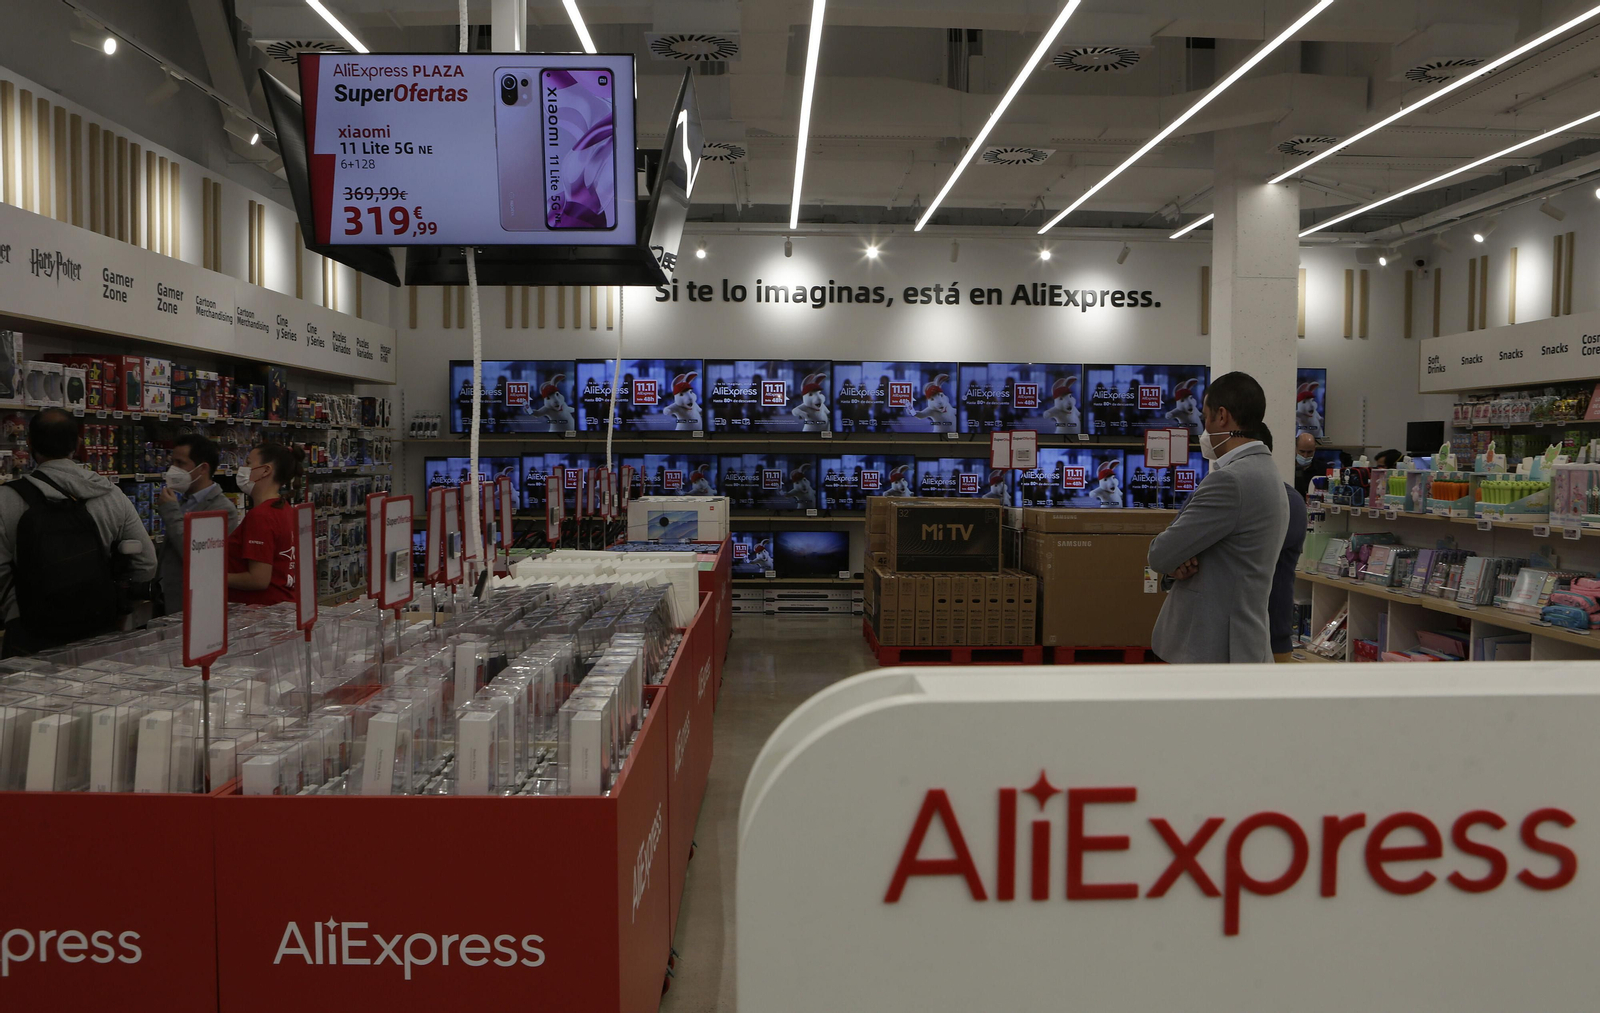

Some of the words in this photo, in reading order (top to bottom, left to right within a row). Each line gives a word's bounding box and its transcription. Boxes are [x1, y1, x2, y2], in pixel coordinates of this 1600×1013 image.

[333, 63, 408, 81] AliExpress
[413, 65, 464, 77] PLAZA
[334, 82, 468, 106] SuperOfertas
[338, 125, 391, 138] xiaomi
[340, 142, 357, 154] 11
[362, 141, 390, 155] Lite
[395, 142, 413, 154] 5G
[419, 145, 433, 154] NE
[341, 159, 376, 169] 6+128
[550, 169, 559, 191] Lite
[551, 195, 560, 210] 5G
[30, 249, 56, 277] Harry
[56, 251, 82, 288] Potter
[103, 268, 134, 288] Gamer
[103, 284, 127, 302] Zone
[157, 283, 184, 301] Gamer
[686, 281, 713, 302] te
[723, 279, 746, 302] lo
[756, 279, 894, 308] imaginas,
[903, 282, 960, 305] está
[970, 287, 1002, 305] en
[1010, 283, 1161, 312] AliExpress.
[157, 298, 178, 314] Zone
[196, 296, 216, 309] Cartoon
[196, 306, 233, 325] Merchandising
[236, 307, 254, 319] Cartoon
[237, 316, 269, 333] Merchandising
[277, 315, 288, 327] Cine
[281, 328, 297, 341] Series
[307, 323, 317, 334] Cine
[311, 336, 325, 348] Series
[1499, 349, 1523, 360] Snacks
[1542, 343, 1568, 356] Snacks
[1428, 355, 1439, 365] Soft
[1461, 354, 1483, 365] Snacks
[1428, 365, 1446, 374] Drinks
[460, 387, 502, 398] AliEpress
[637, 383, 655, 391] 11.11
[712, 386, 757, 397] AliExpress
[765, 384, 783, 392] 11.11
[840, 387, 884, 398] AliExpress
[892, 385, 910, 393] 11.11
[1018, 386, 1035, 395] 11.11
[966, 388, 1010, 400] AliExpress
[1093, 390, 1135, 401] AliExpress
[527, 473, 546, 482] AliExp
[922, 524, 943, 540] Mi
[946, 524, 974, 540] TV
[883, 768, 1578, 936] AliExpress
[631, 802, 662, 924] AliExpress
[273, 915, 546, 981] AliExpress
